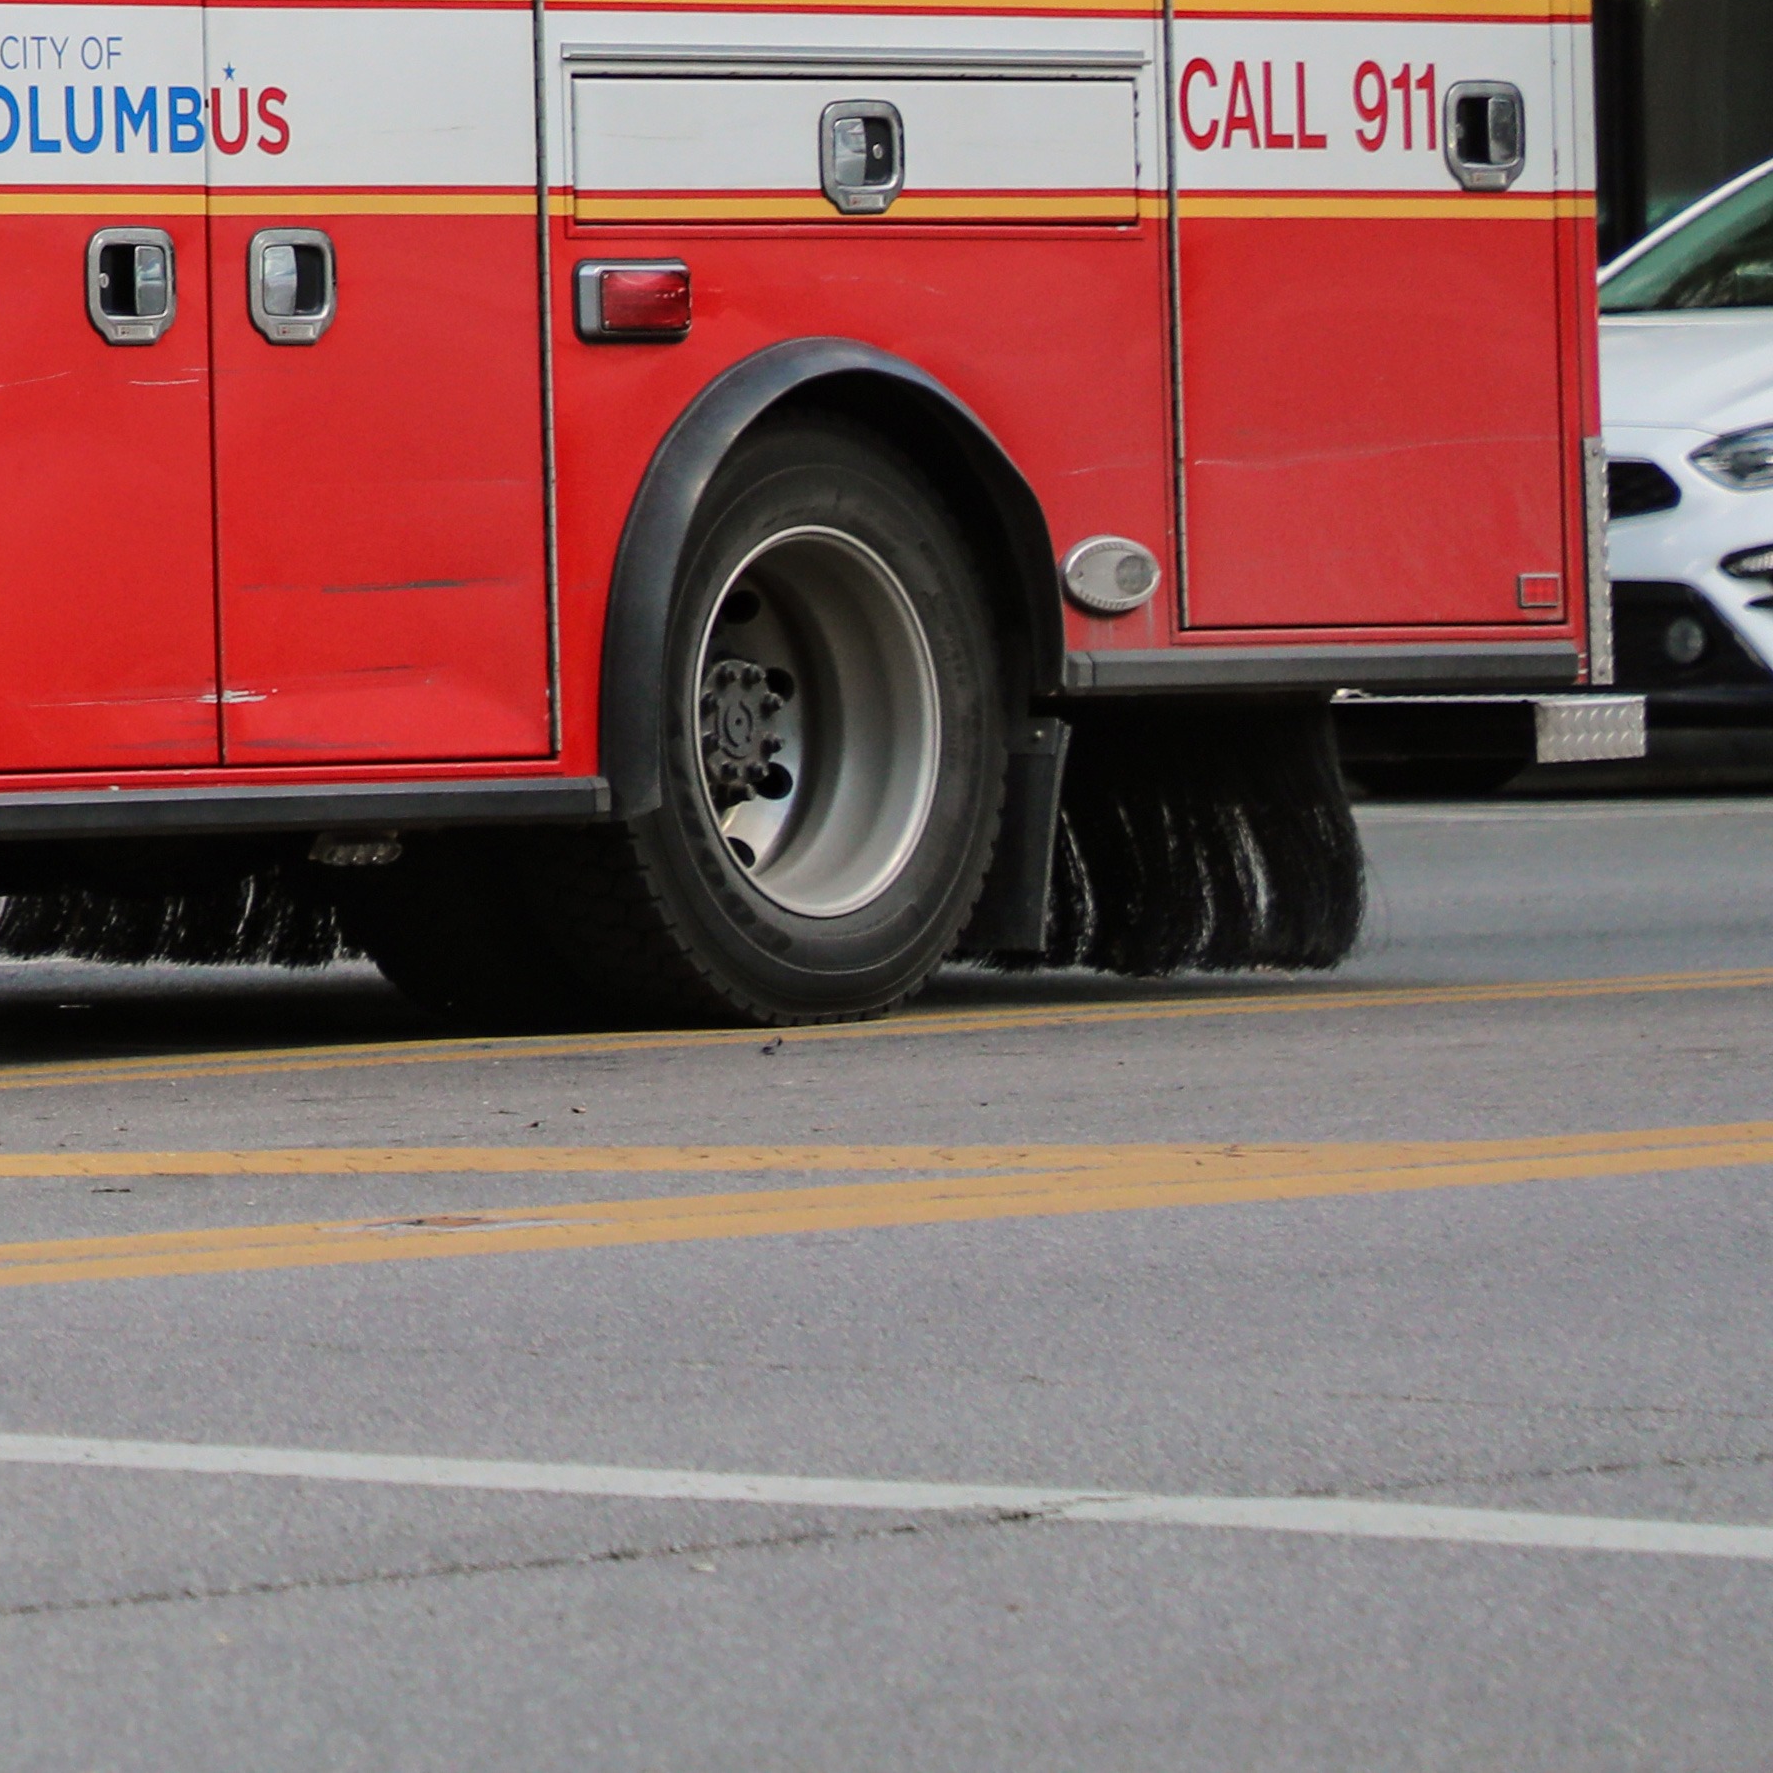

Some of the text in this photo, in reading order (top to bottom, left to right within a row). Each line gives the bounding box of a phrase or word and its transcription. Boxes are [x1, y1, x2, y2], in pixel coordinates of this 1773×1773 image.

[0, 35, 69, 70] CITY
[81, 36, 123, 70] OF
[1178, 57, 1438, 153] CALL 911
